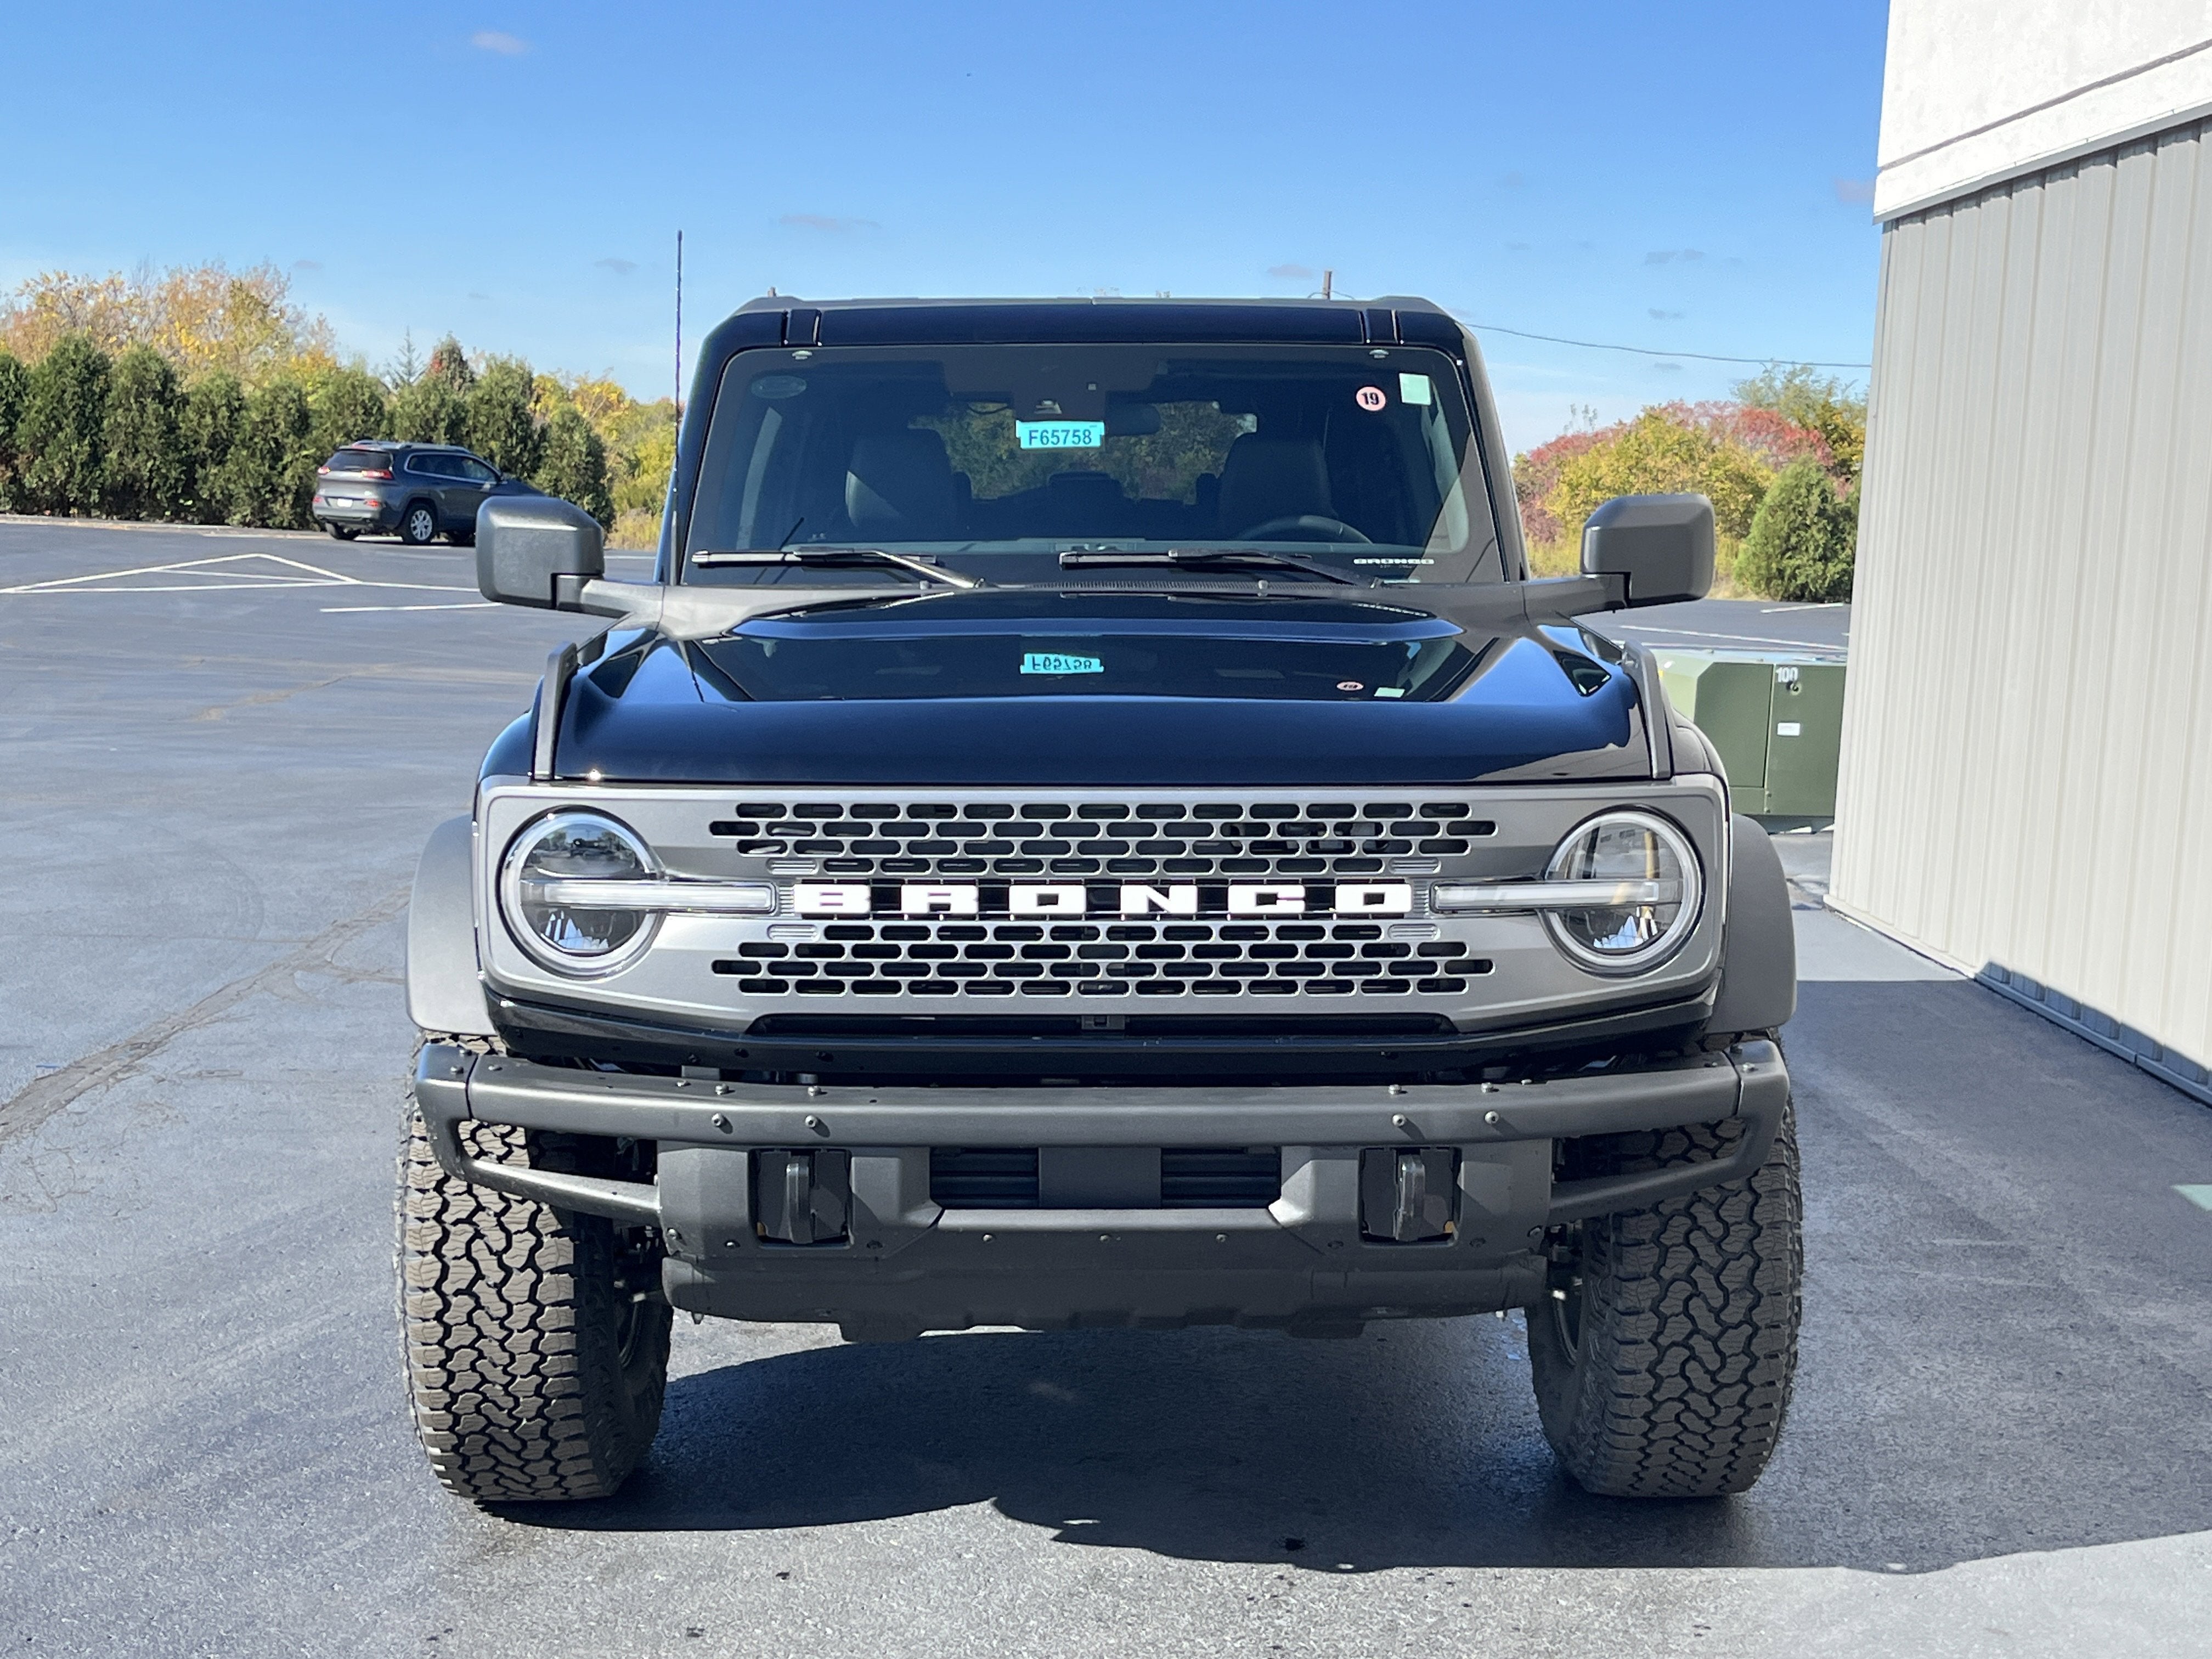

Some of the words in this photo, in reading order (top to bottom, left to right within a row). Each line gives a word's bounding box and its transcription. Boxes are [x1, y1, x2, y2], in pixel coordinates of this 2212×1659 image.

[1361, 392, 1379, 405] 19
[1029, 429, 1092, 445] F65758
[793, 883, 1412, 914] BRONCO
